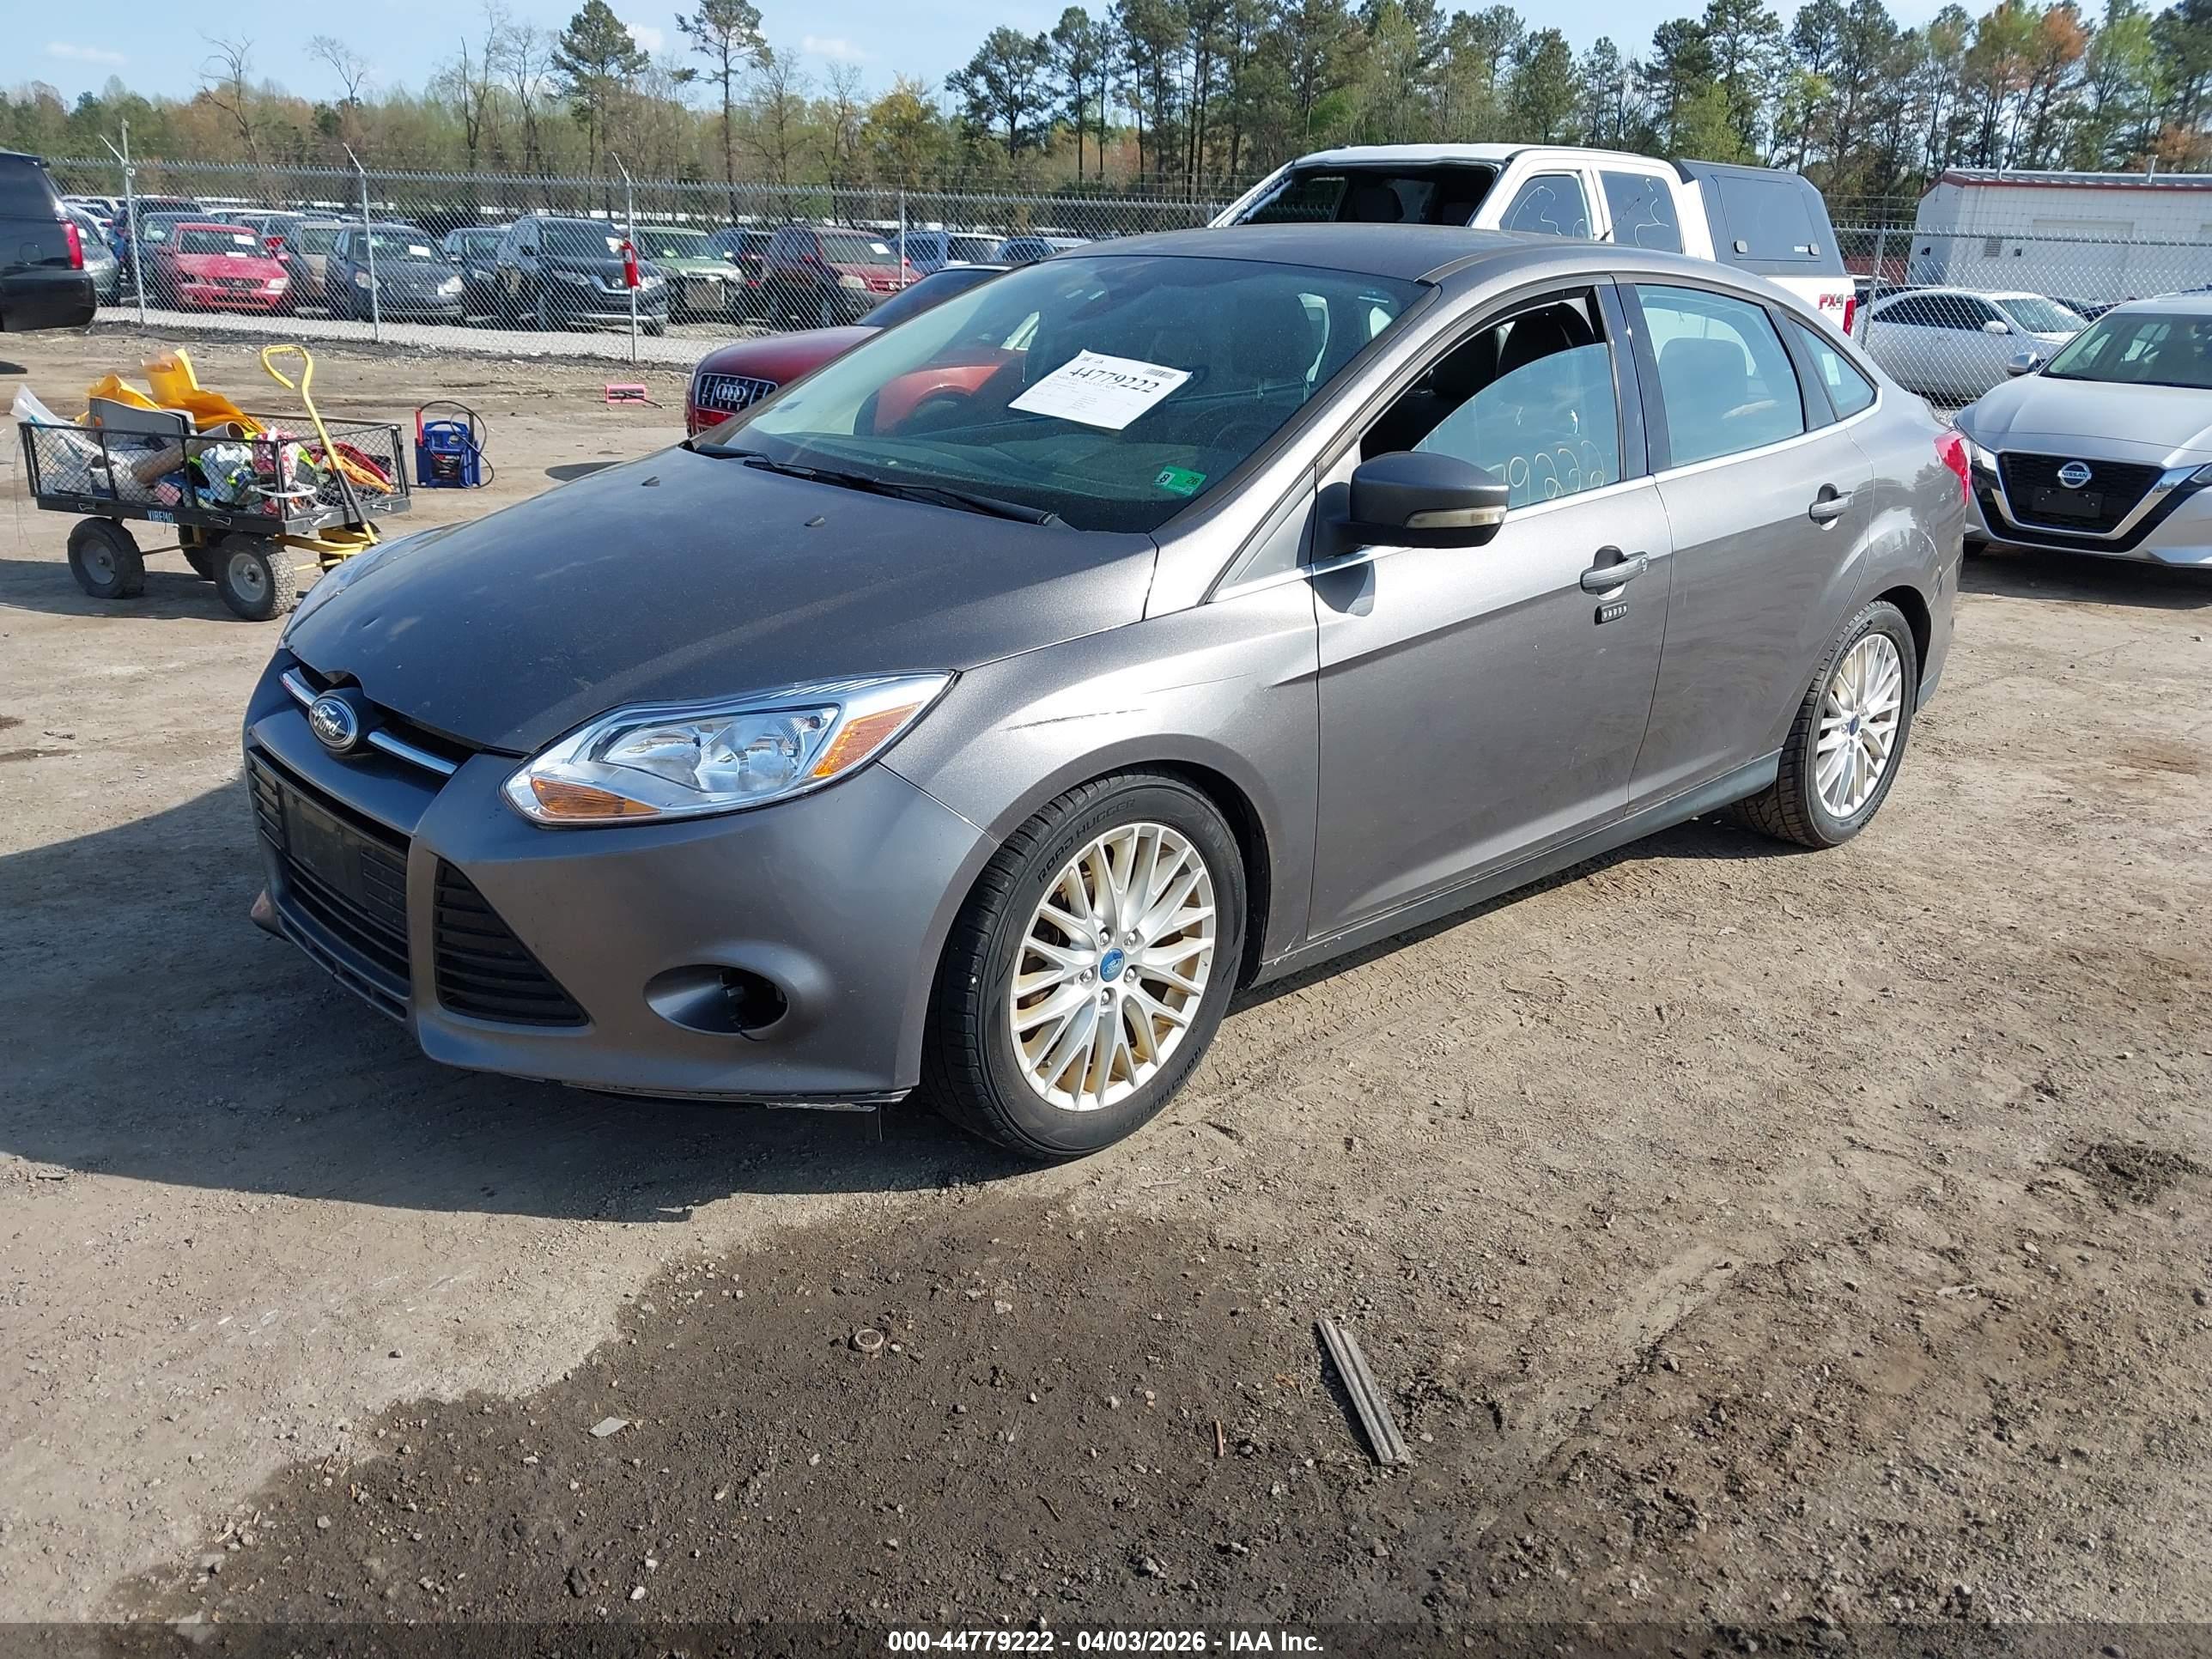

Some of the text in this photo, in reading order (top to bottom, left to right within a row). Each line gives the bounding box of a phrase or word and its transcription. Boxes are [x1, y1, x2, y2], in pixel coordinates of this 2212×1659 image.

[1819, 294, 1844, 309] FX4
[1068, 367, 1160, 393] 44779222
[1159, 473, 1170, 483] 8
[312, 704, 343, 737] Ford
[1037, 798, 1135, 884] ROAD HUGGER
